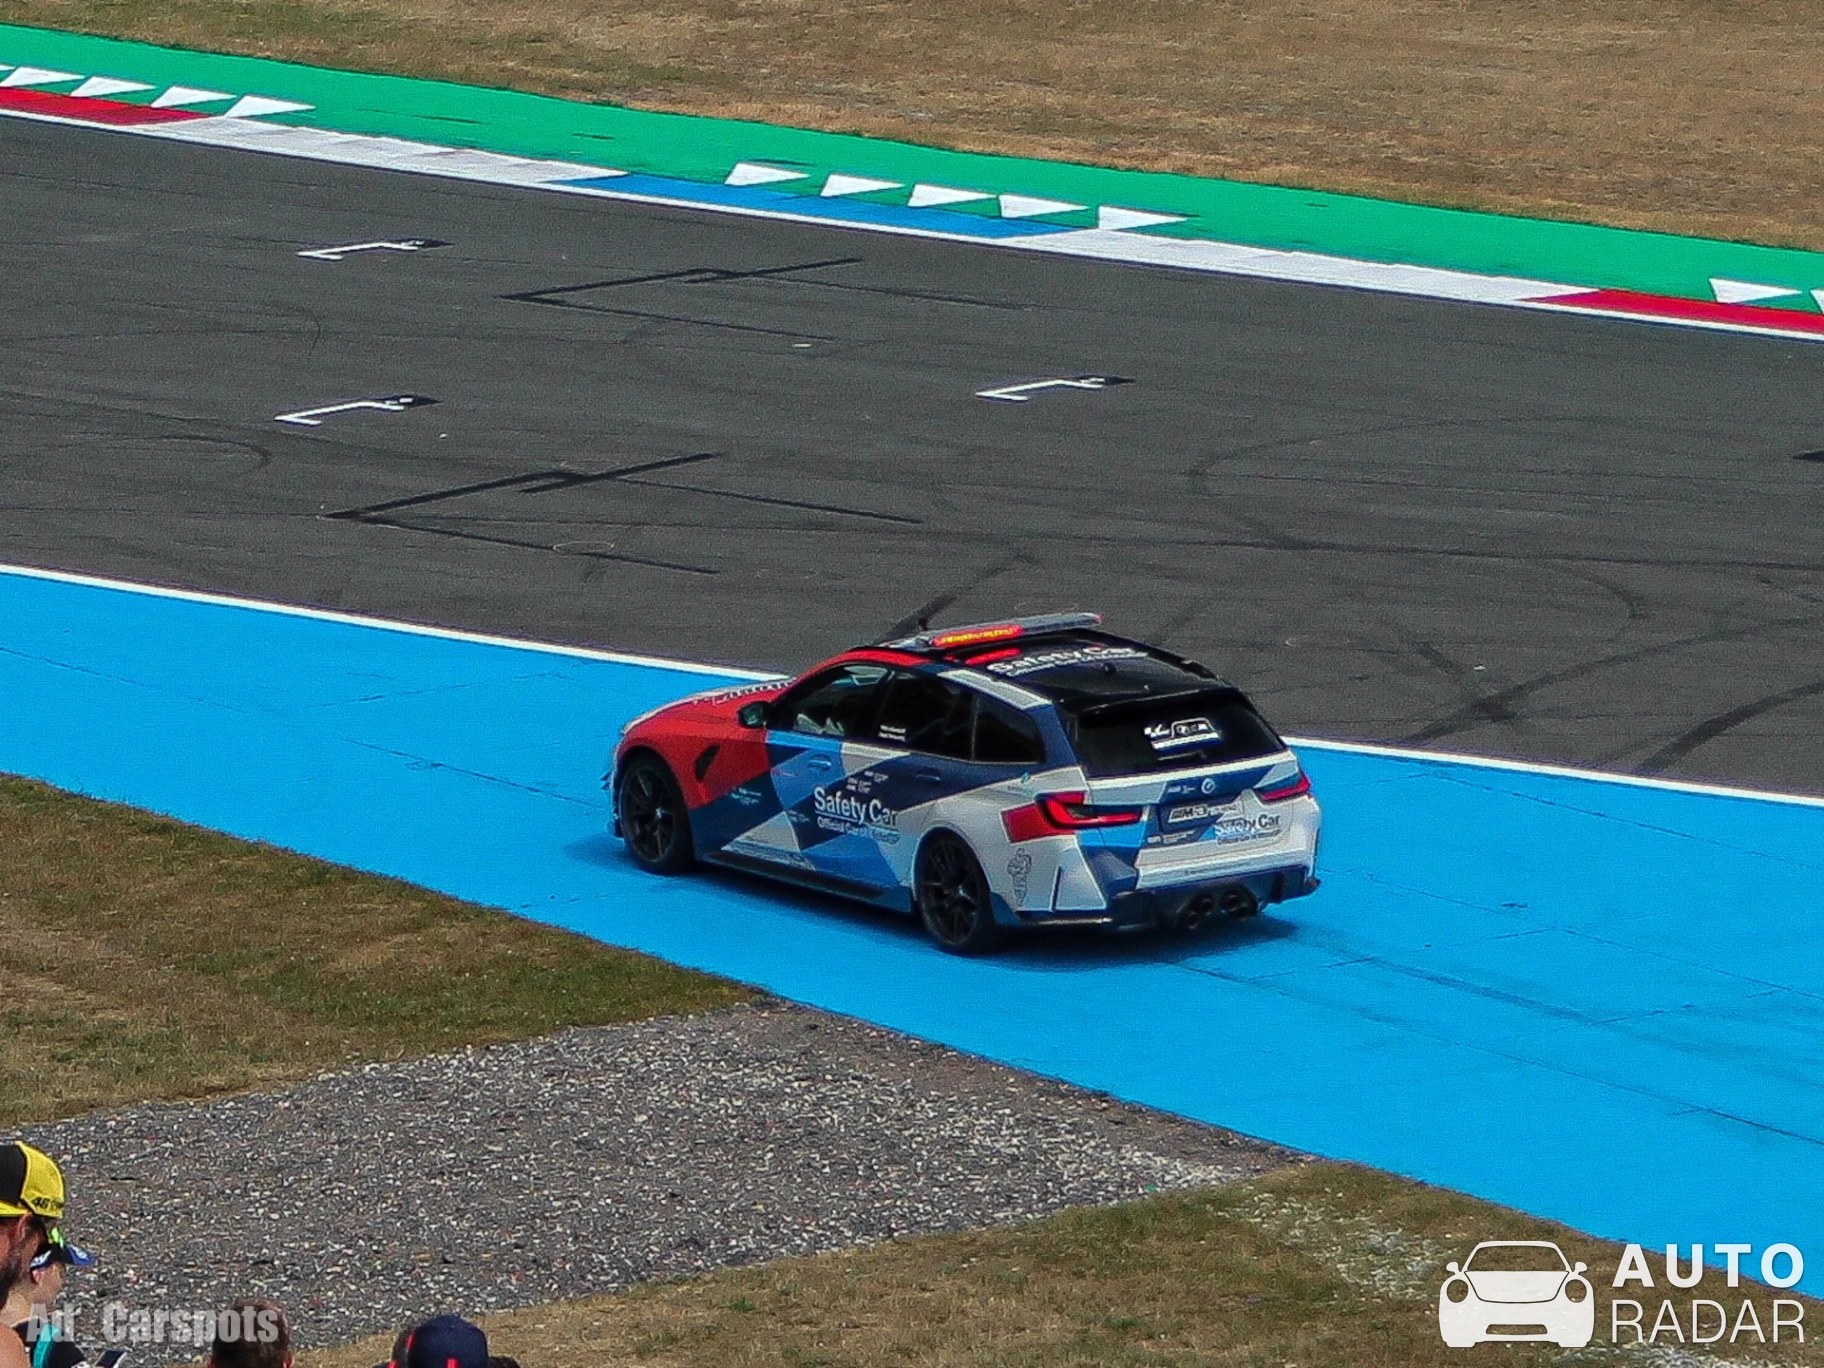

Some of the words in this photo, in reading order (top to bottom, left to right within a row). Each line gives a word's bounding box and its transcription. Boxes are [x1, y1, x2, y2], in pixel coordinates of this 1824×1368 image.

[986, 650, 1082, 673] Safety
[813, 786, 867, 825] Safety
[869, 798, 898, 826] Car
[1215, 818, 1256, 834] Safety
[1258, 813, 1280, 828] Car
